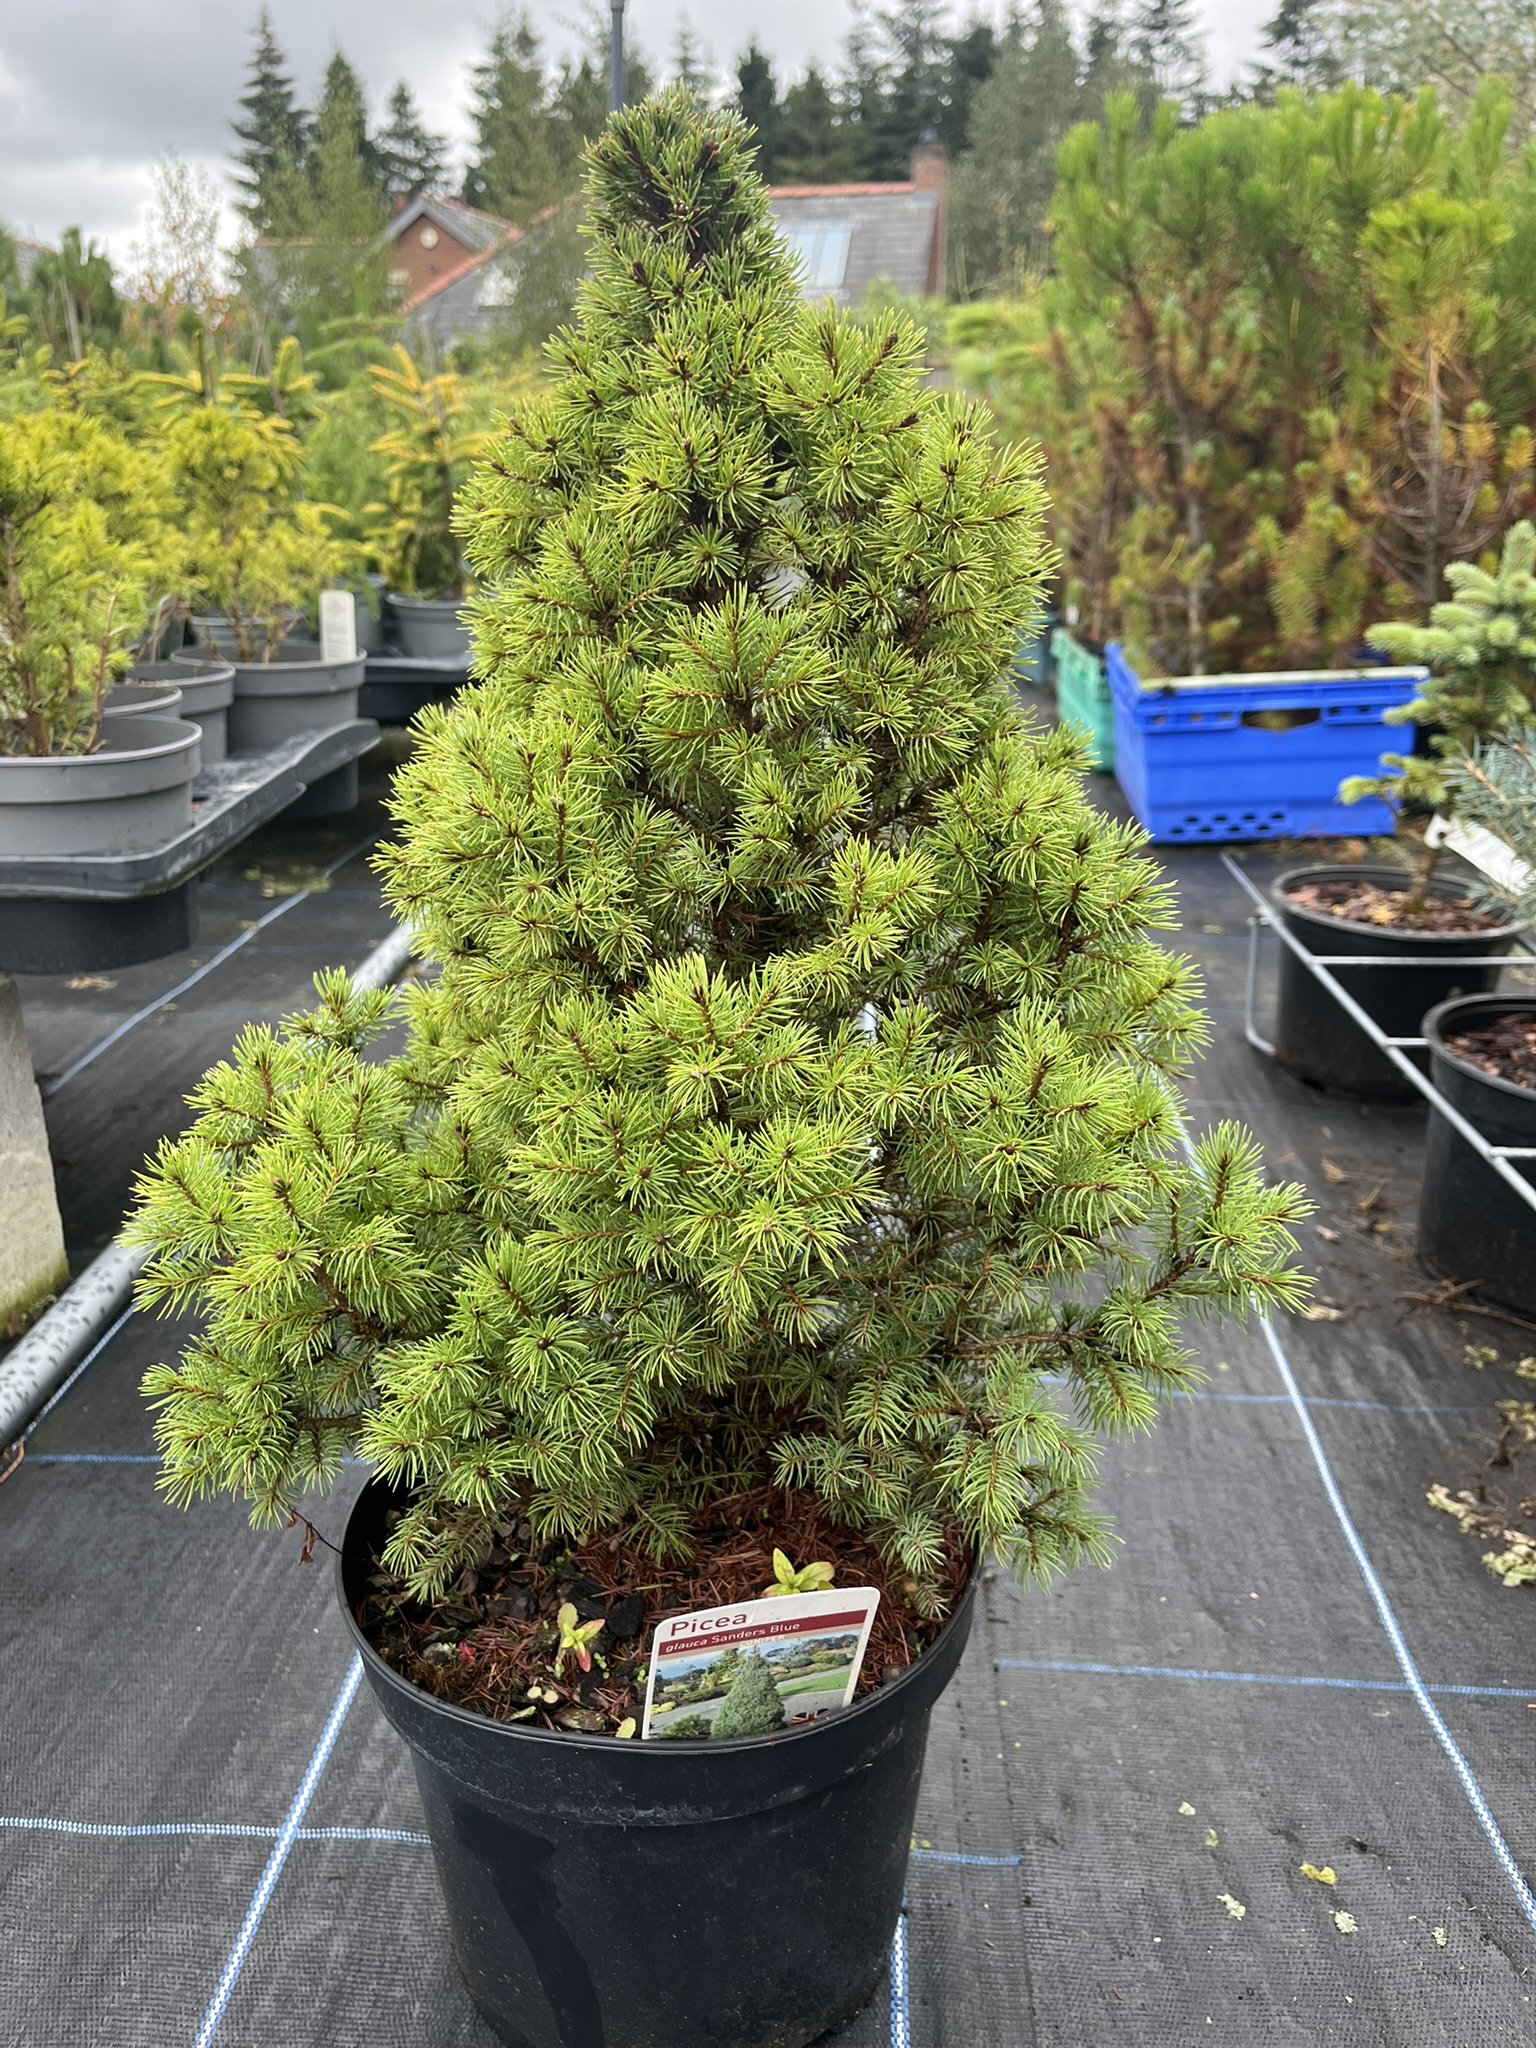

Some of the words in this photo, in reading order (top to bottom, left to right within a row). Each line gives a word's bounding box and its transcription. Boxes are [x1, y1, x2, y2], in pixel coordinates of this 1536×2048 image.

[670, 1613, 747, 1637] Picea
[665, 1639, 708, 1653] glauca
[711, 1627, 766, 1644] Sanders
[770, 1622, 801, 1633] Blue
[738, 1634, 785, 1647] CONIFER
